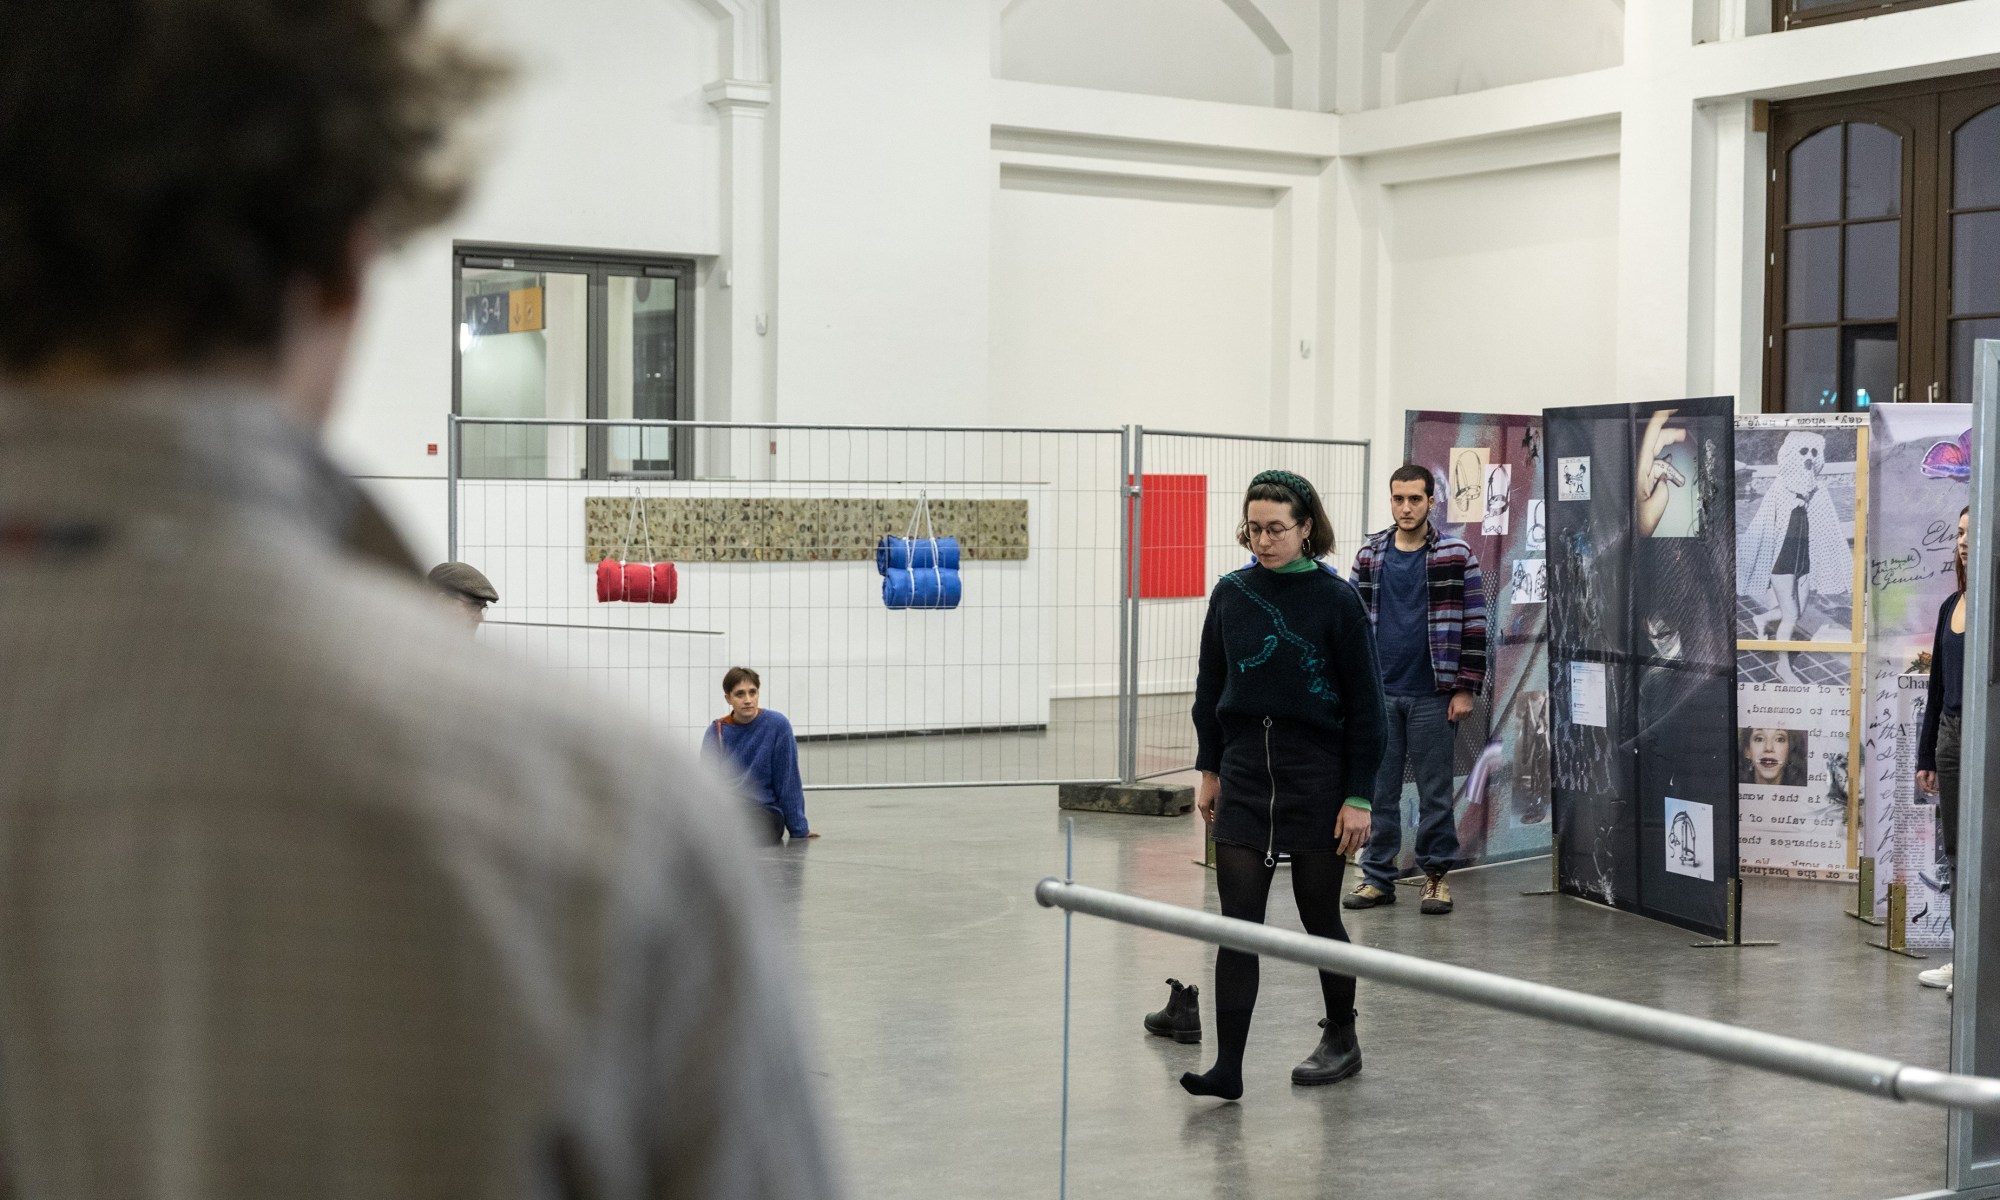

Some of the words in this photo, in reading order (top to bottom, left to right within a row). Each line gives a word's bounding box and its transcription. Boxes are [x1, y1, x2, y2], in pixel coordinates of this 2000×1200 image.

[481, 296, 501, 324] 3-4
[1797, 417, 1826, 426] whom
[1740, 866, 1789, 877] busines
[1797, 870, 1817, 879] the
[1825, 871, 1840, 880] or
